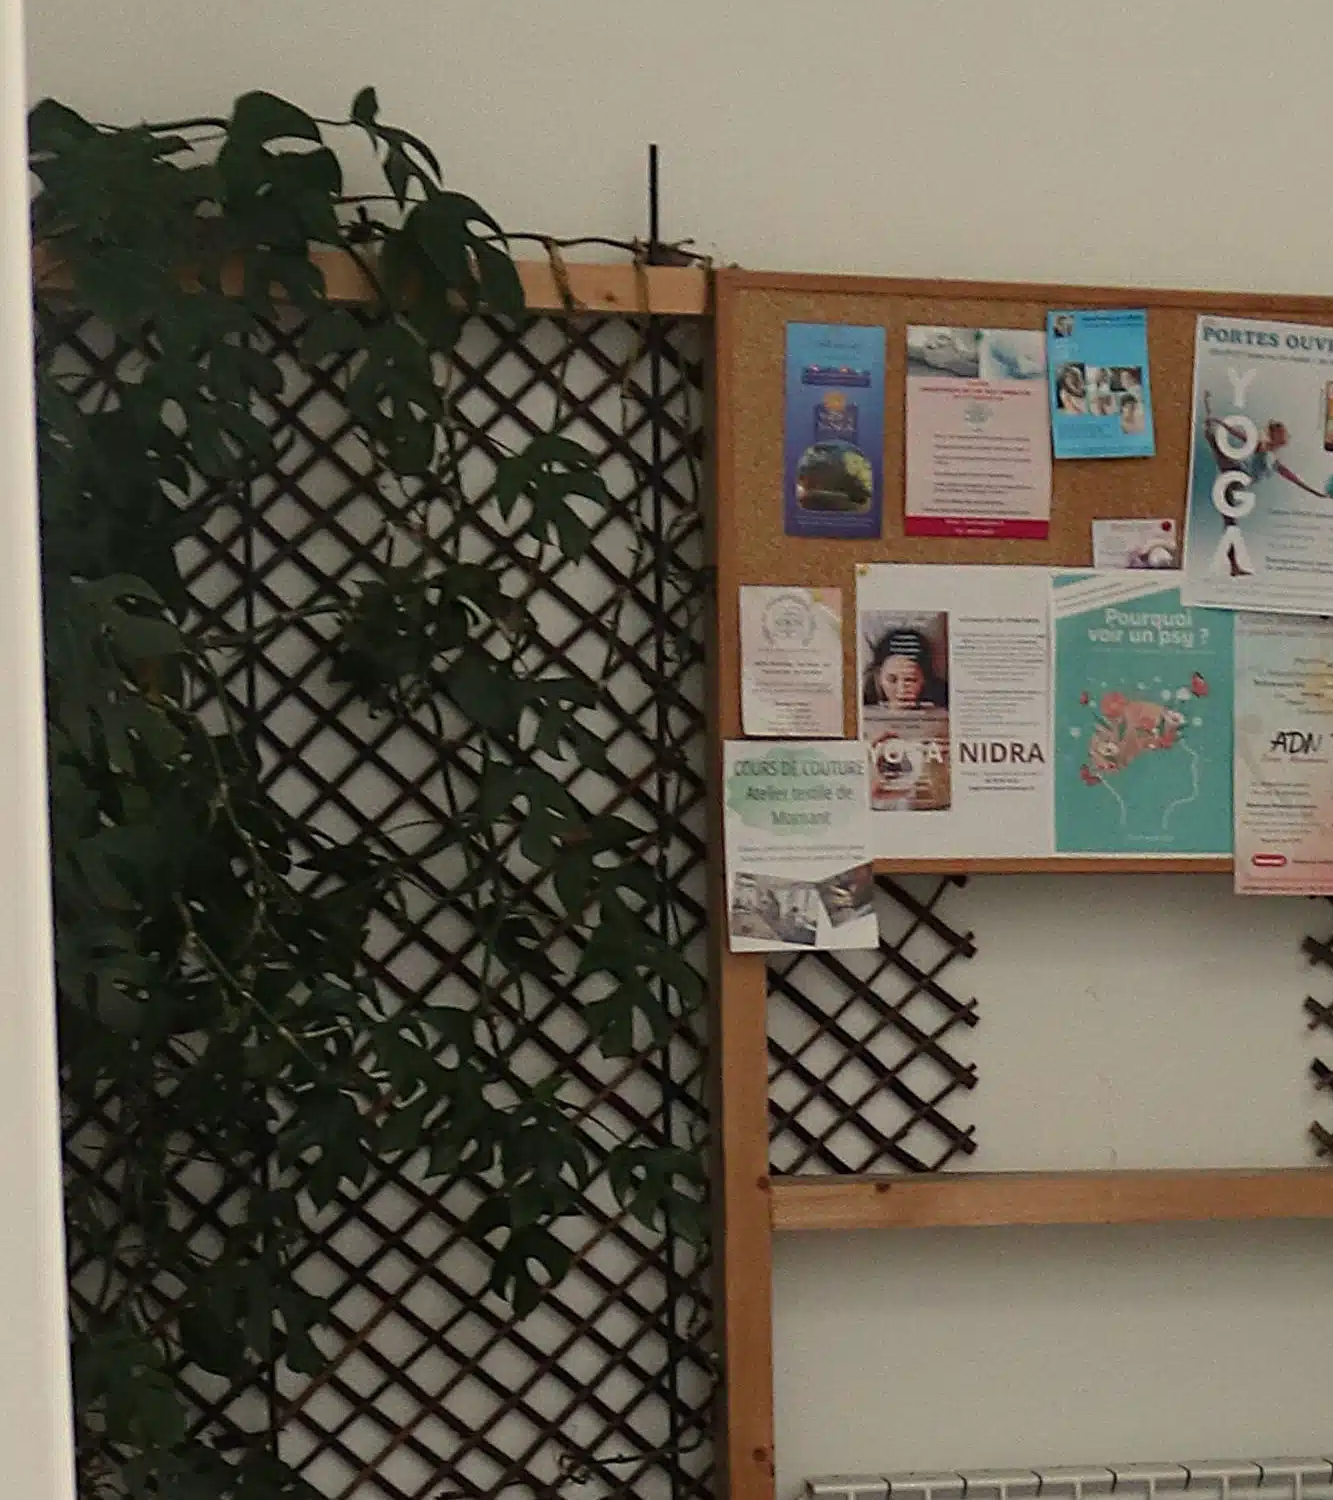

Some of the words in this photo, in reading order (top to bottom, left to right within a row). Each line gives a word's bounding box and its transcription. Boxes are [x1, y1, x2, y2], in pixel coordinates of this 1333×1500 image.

[1203, 326, 1280, 349] PORTES
[1210, 367, 1259, 578] YOGA
[1104, 607, 1192, 628] Pourquoi
[1088, 628, 1124, 642] voir
[1128, 629, 1153, 643] un
[1159, 630, 1195, 648] psy
[960, 741, 1045, 764] NIDRA
[1270, 730, 1323, 754] ADN
